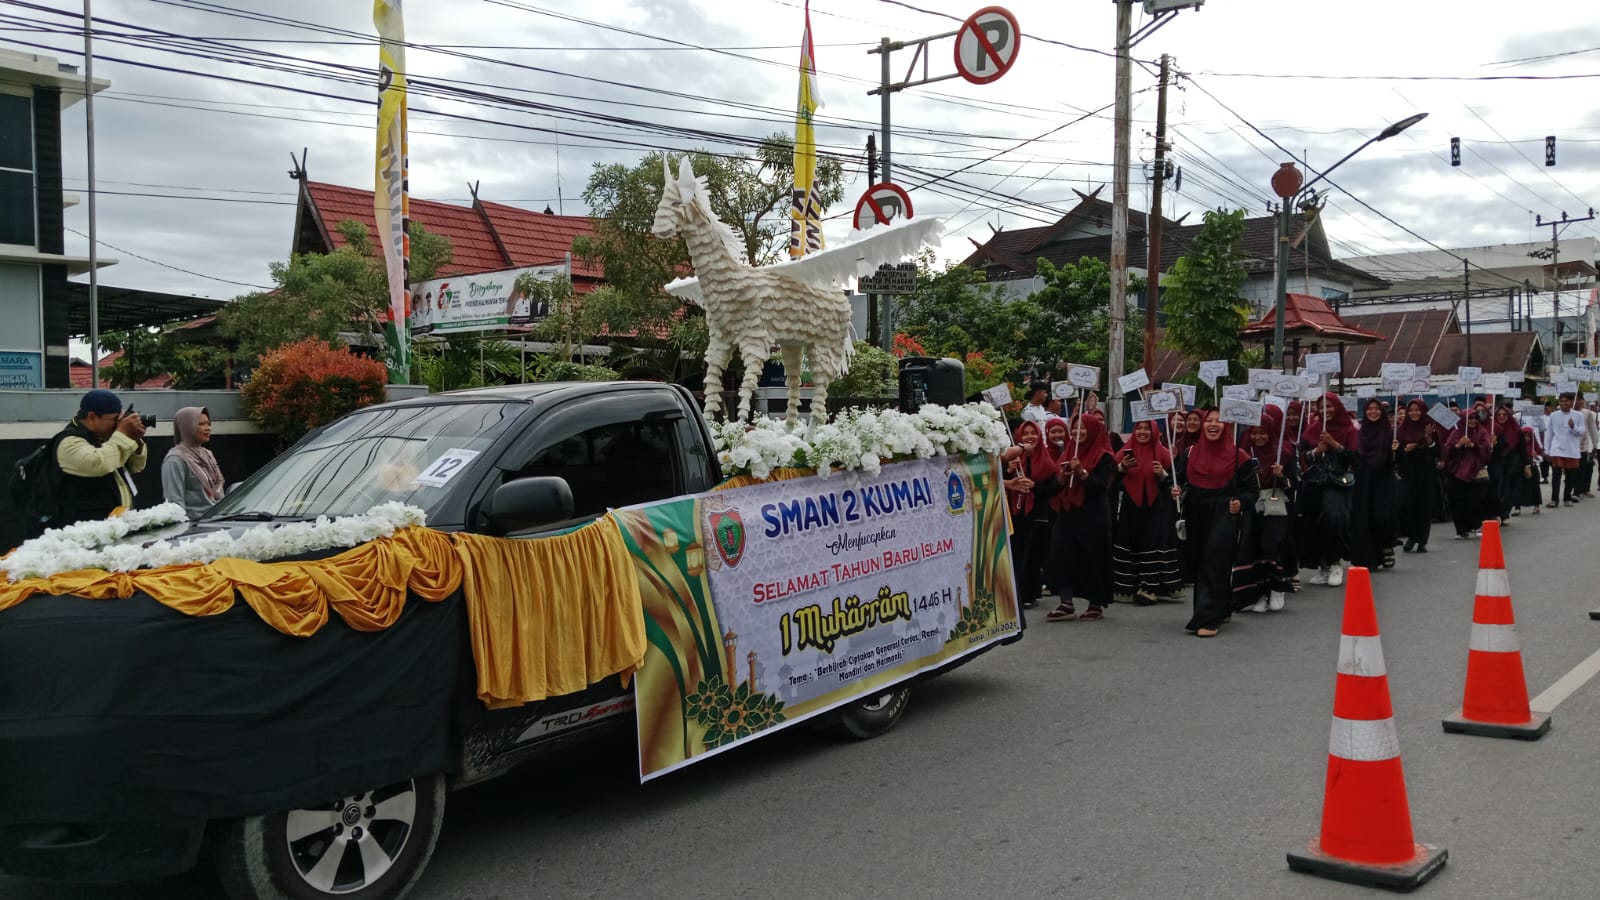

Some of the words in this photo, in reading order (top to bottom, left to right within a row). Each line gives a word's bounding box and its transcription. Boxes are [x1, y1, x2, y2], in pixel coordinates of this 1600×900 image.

[429, 457, 463, 479] 12
[760, 492, 840, 538] SMAN
[842, 489, 860, 523] 2
[860, 476, 933, 518] KUMAI
[752, 569, 829, 604] SELAMAT
[831, 557, 881, 583] TAHUN
[882, 547, 919, 569] BARU
[920, 537, 954, 558] ISLAM
[780, 611, 792, 656] 1
[912, 591, 940, 614] 1446
[941, 587, 953, 603] H
[788, 673, 808, 687] Tema
[848, 650, 875, 666] Ciptakan
[875, 639, 900, 656] Generasi
[838, 665, 863, 682] Mandiri
[863, 662, 875, 673] dan
[541, 711, 583, 731] TRD
